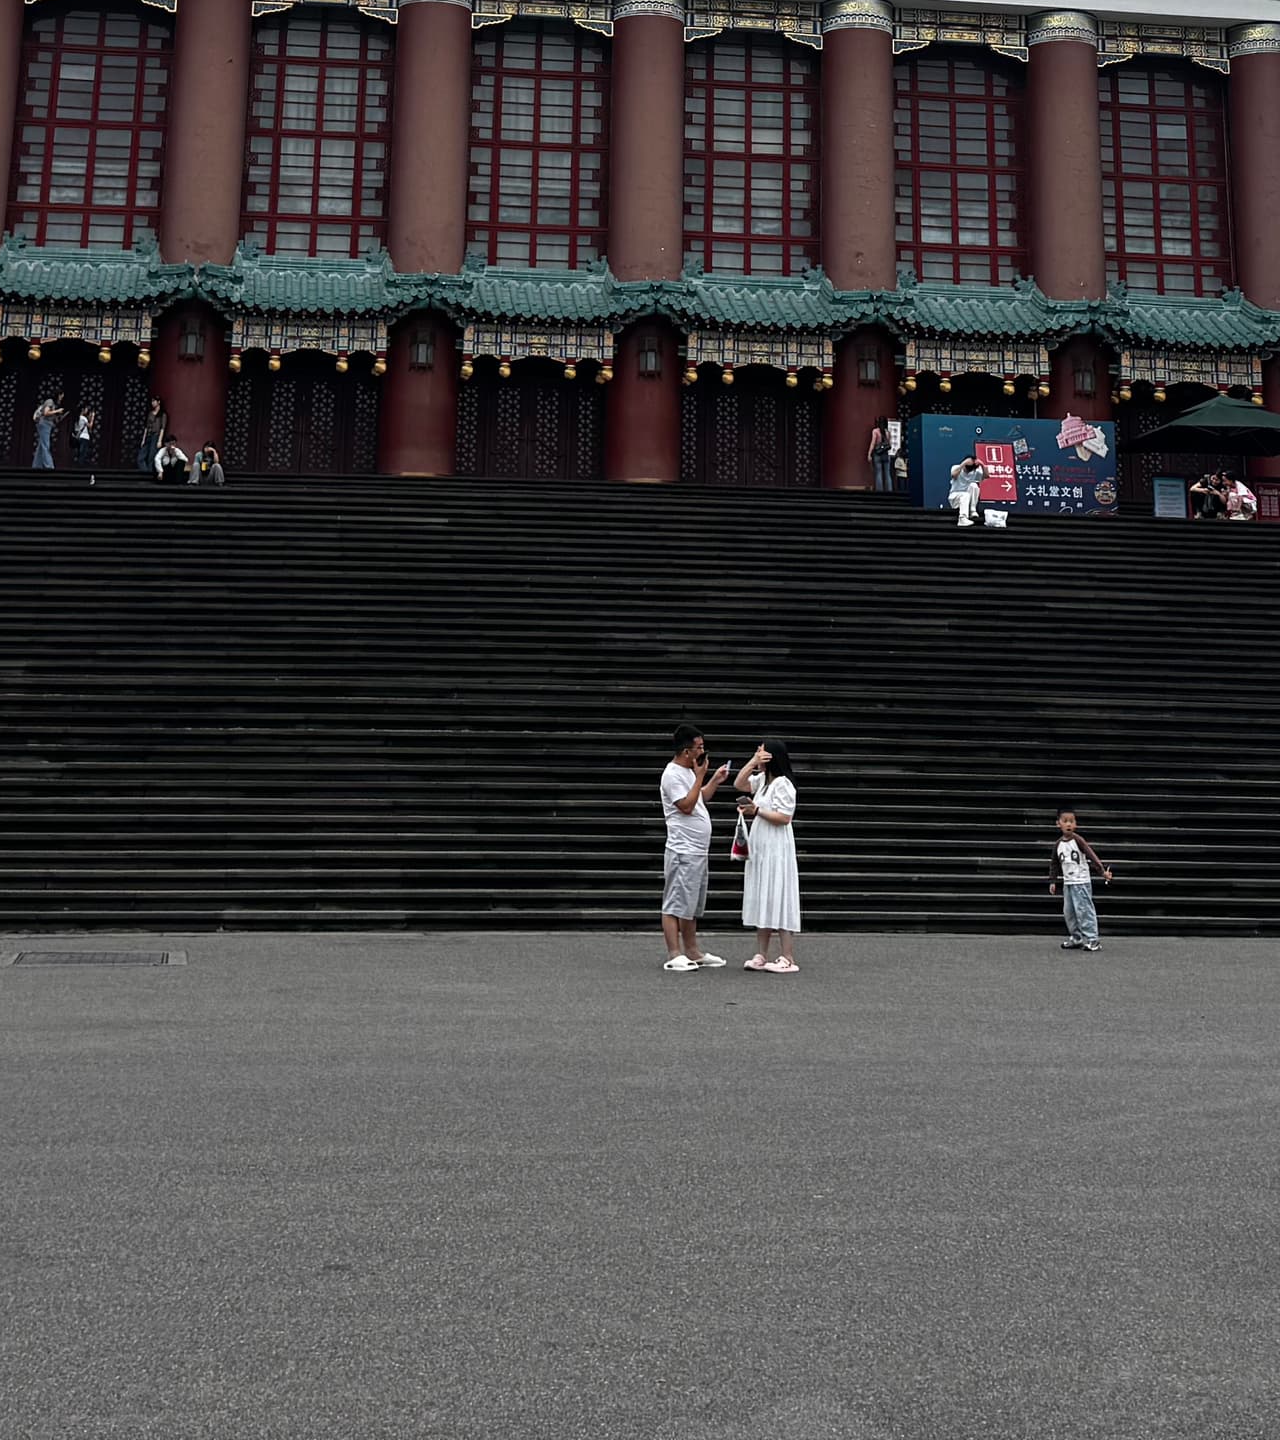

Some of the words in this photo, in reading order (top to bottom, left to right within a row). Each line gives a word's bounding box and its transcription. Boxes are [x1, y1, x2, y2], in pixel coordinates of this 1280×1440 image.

[1025, 484, 1083, 499] 大礼堂文创
